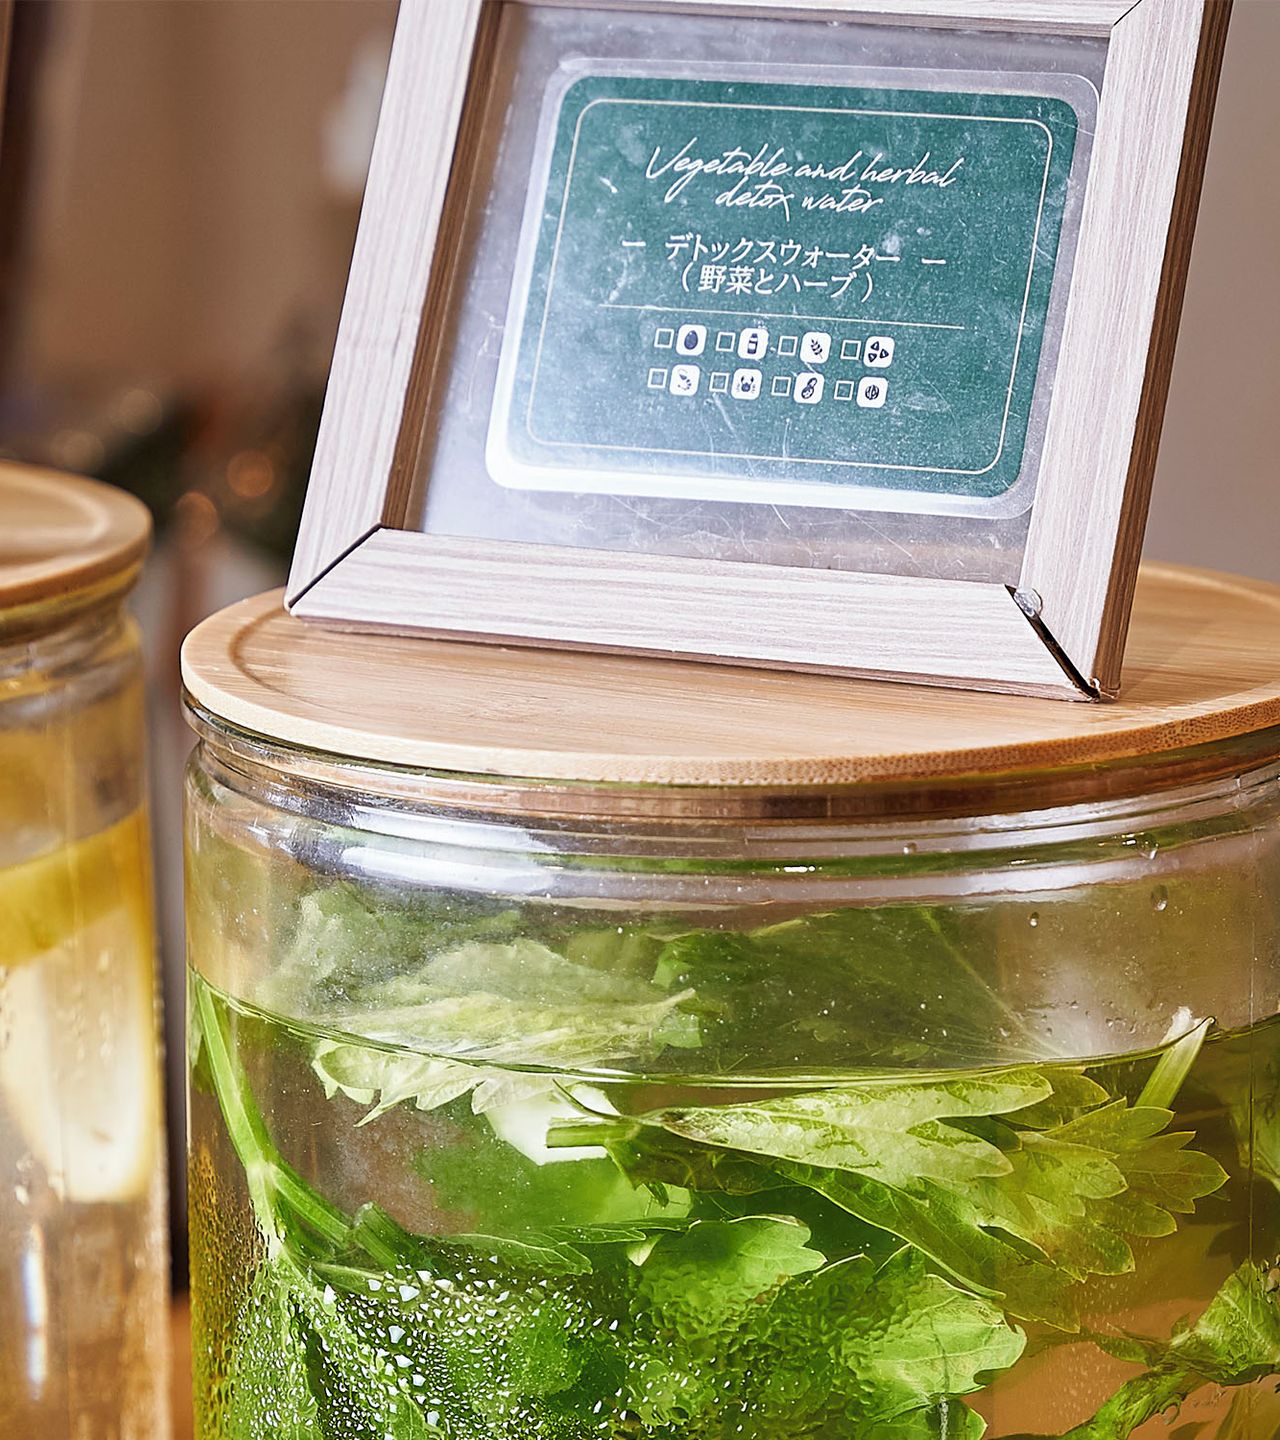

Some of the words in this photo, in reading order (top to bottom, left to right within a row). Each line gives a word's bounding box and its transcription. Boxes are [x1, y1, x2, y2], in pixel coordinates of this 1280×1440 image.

[645, 137, 792, 204] Vegetable
[794, 150, 861, 184] and
[857, 152, 966, 189] herbal
[714, 178, 795, 222] detox
[801, 184, 884, 214] water
[665, 233, 902, 268] デトックスウォーター
